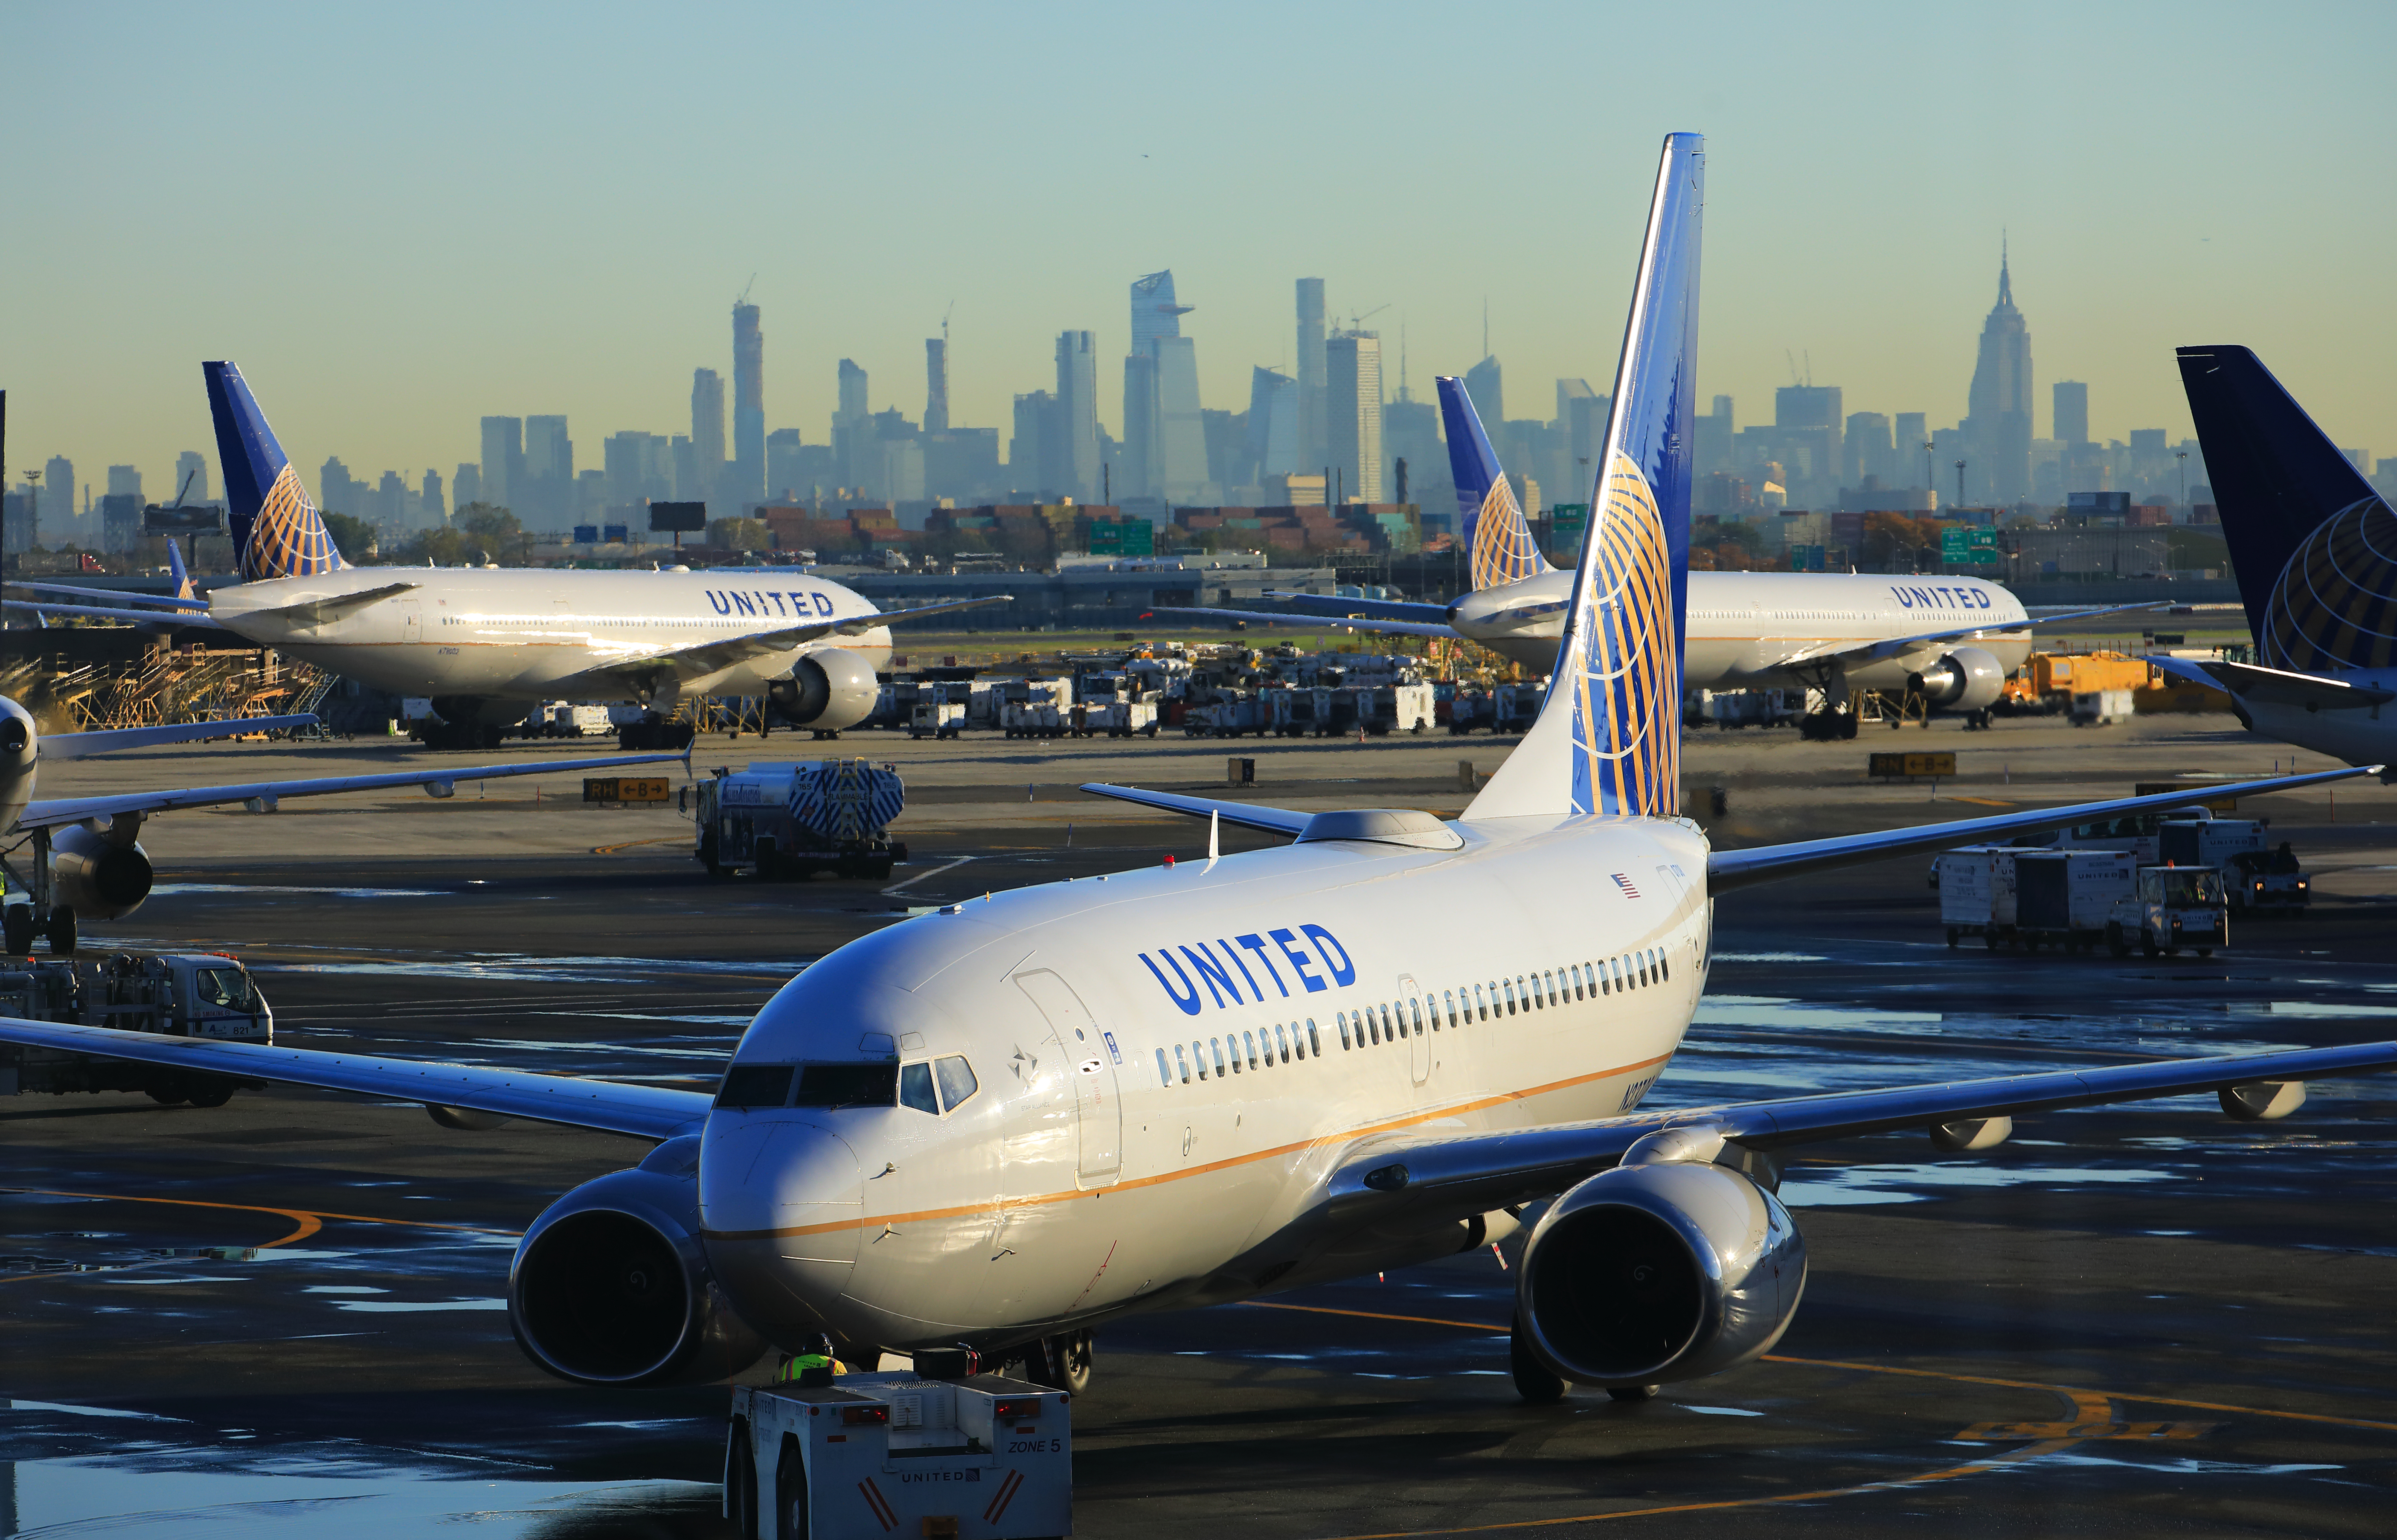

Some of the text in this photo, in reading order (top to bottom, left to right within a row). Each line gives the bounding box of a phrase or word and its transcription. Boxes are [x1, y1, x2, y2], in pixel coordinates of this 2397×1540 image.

[705, 590, 835, 616] UNITED
[1891, 587, 1991, 608] UNITED
[592, 783, 648, 797] RH B
[1138, 924, 1356, 1015] UNITED
[233, 1026, 249, 1034] 821
[752, 1398, 771, 1415] UNITED
[1008, 1439, 1061, 1453] ZONE 5
[902, 1471, 964, 1483] UNITED
